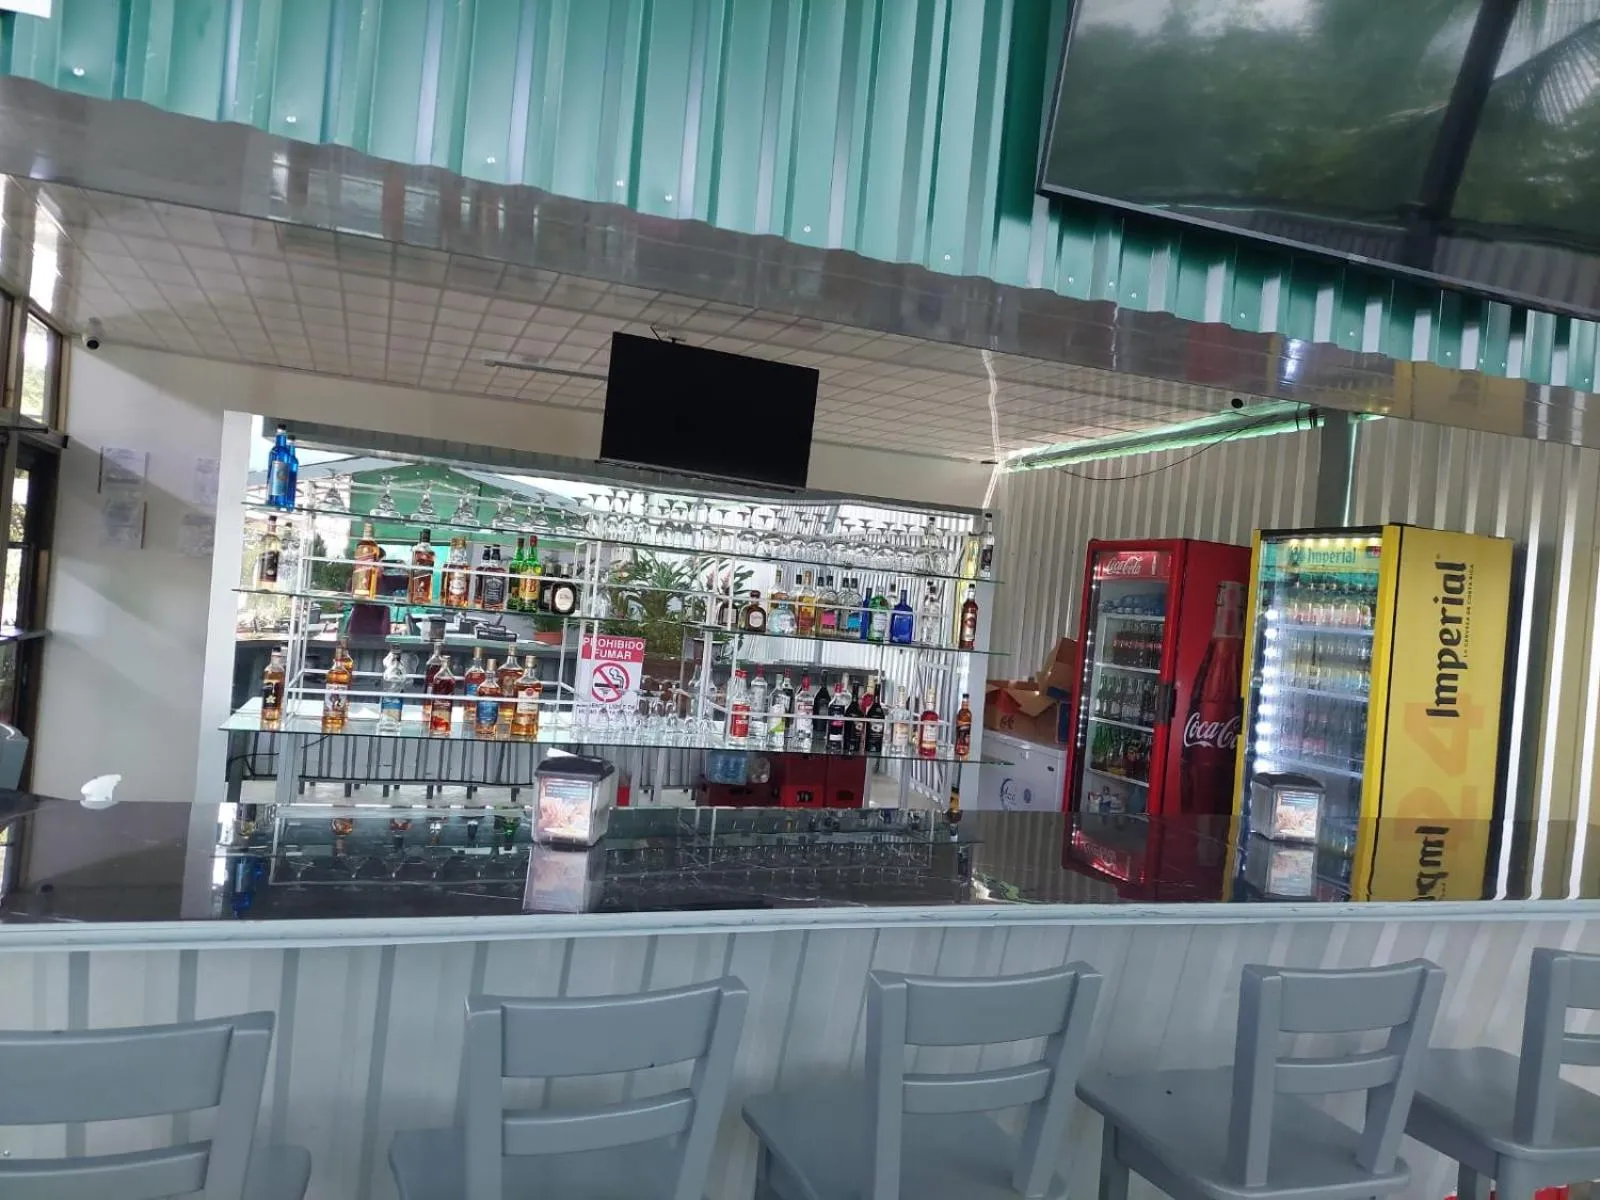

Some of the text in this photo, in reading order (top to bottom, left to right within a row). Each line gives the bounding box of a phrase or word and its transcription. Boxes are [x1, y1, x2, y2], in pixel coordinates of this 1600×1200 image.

[1308, 546, 1357, 564] Imperial
[583, 637, 644, 651] POHIBIDO
[1425, 561, 1468, 718] Imperial
